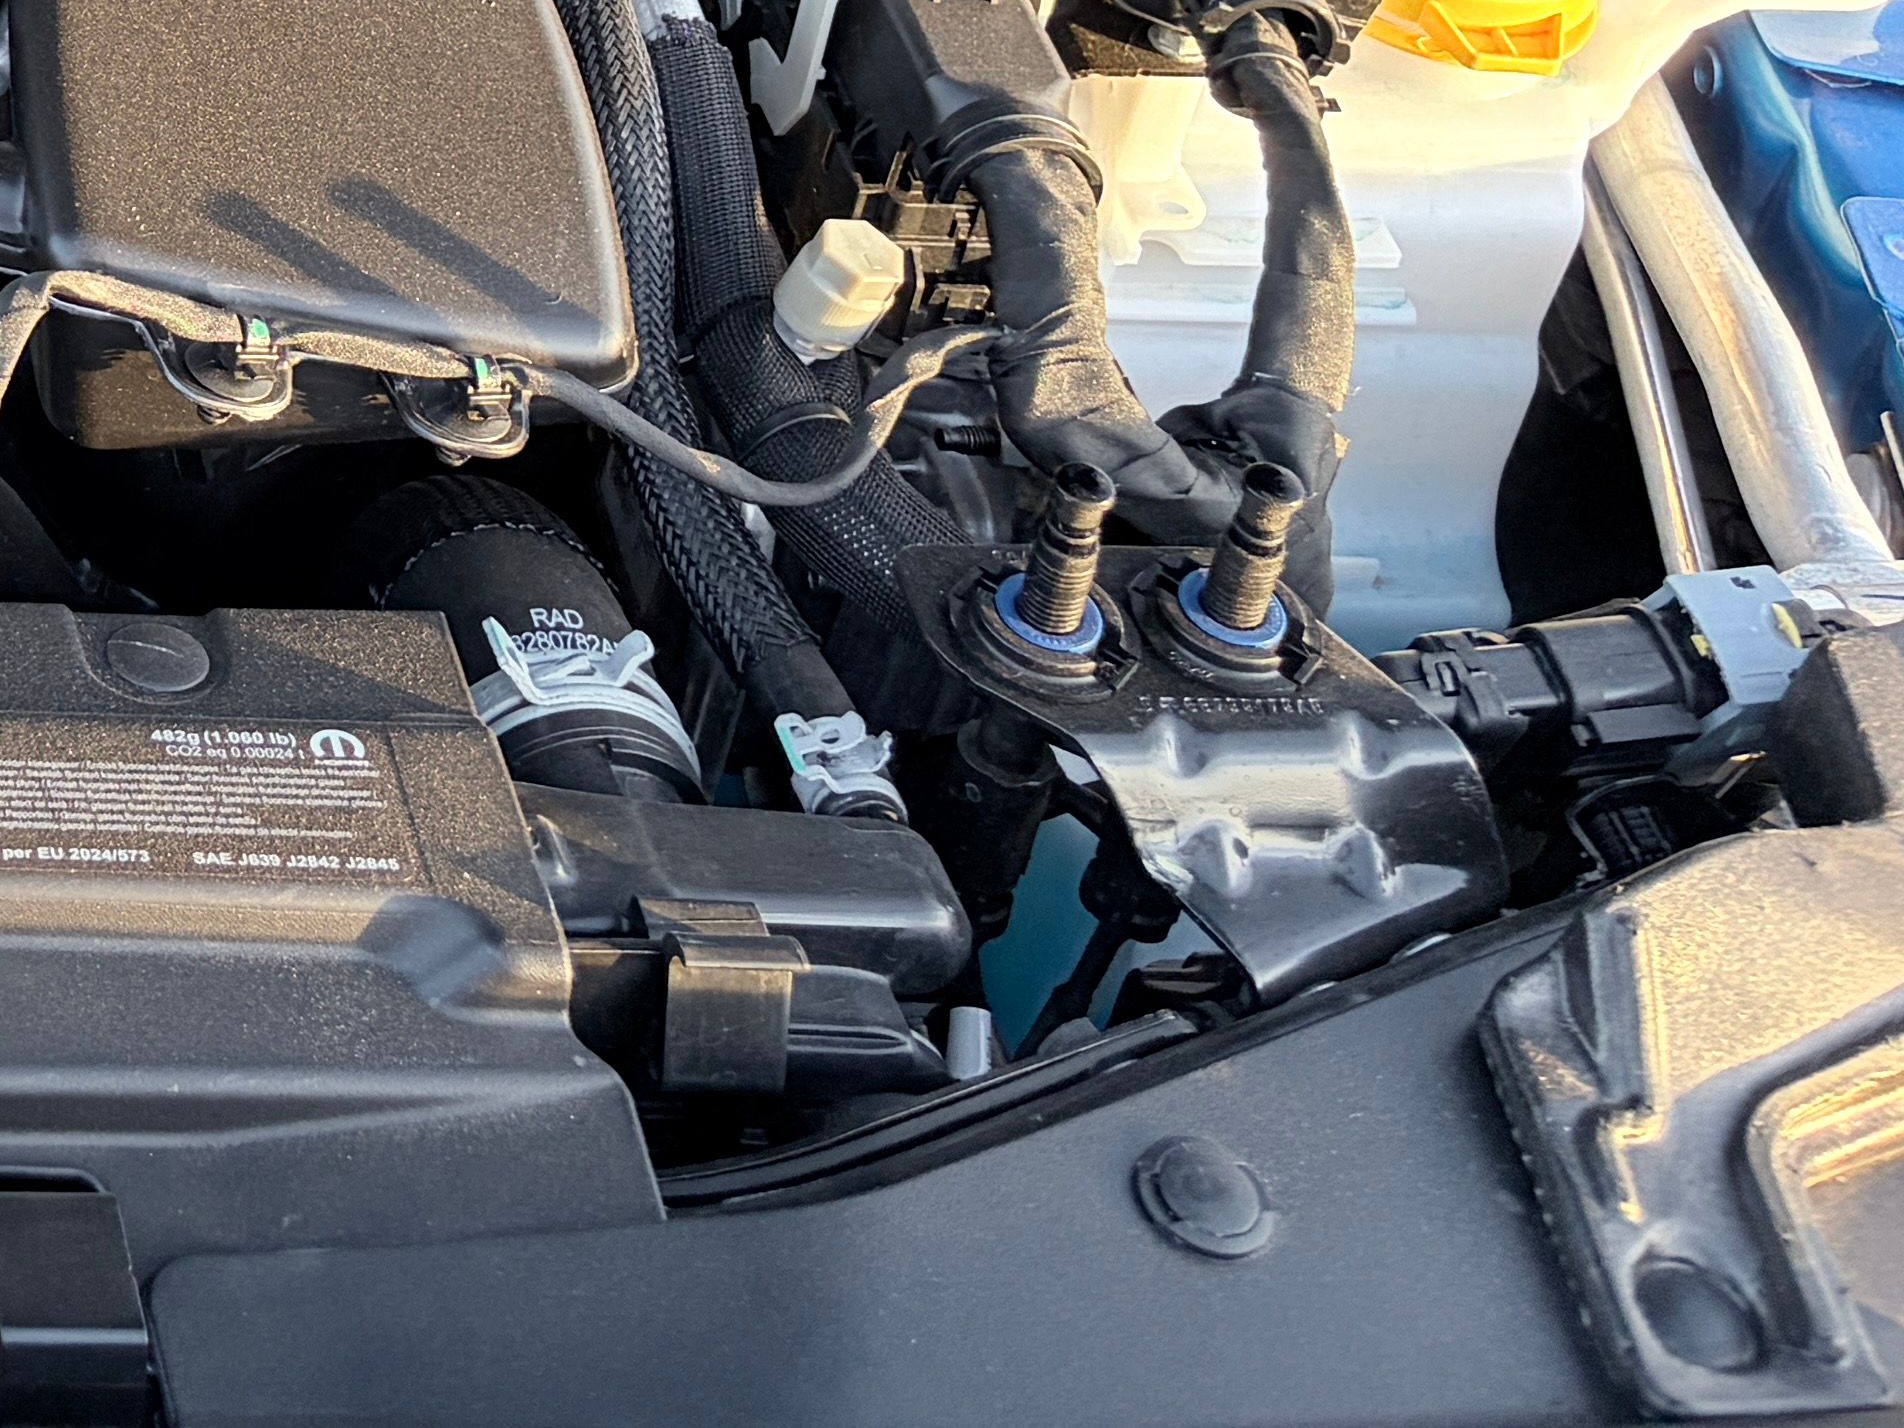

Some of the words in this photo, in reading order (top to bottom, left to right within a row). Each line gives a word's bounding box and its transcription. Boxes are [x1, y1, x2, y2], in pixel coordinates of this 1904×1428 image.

[529, 607, 584, 629] RAD
[511, 631, 620, 656] 8280782A
[150, 729, 200, 745] 482g
[270, 731, 297, 748] lb)
[165, 746, 202, 757] CO2
[206, 748, 228, 760] eq
[2, 846, 33, 861] per
[36, 846, 64, 860] EU
[68, 846, 151, 863] 2024/573
[193, 852, 236, 865] SAE
[286, 855, 341, 869] J2842
